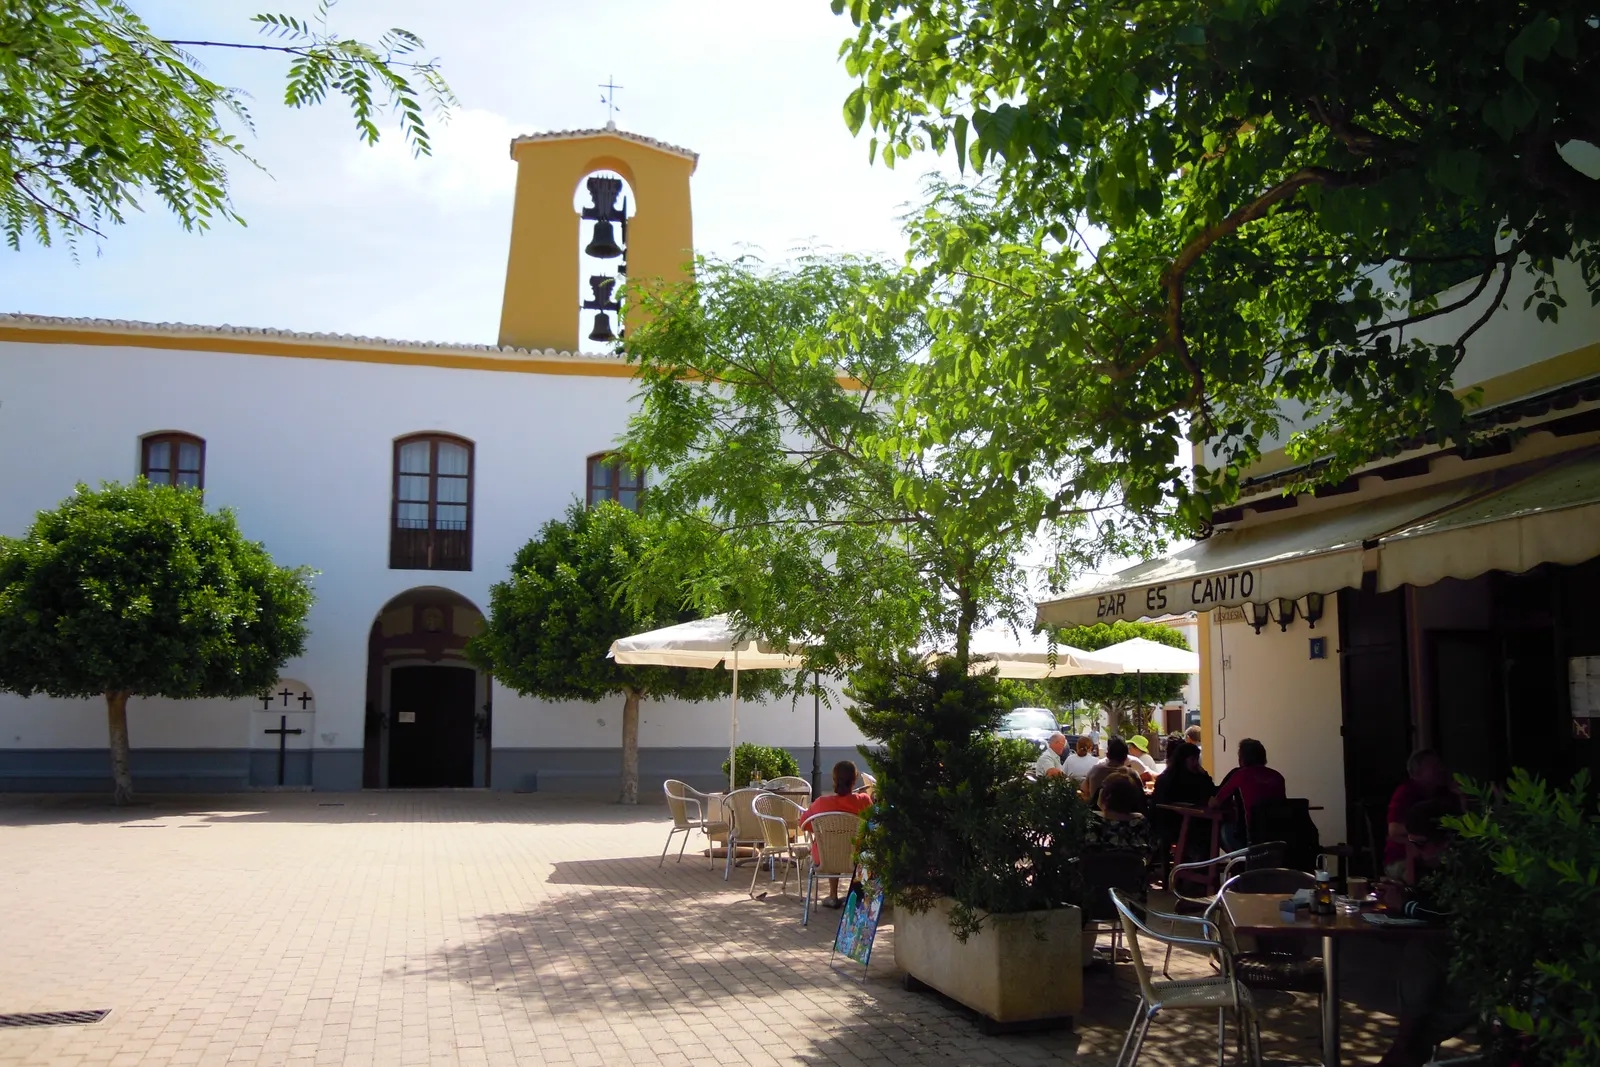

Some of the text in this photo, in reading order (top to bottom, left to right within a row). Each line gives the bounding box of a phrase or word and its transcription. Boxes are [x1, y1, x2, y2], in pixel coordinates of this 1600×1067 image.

[1097, 570, 1254, 617] BAR ES CANTO
